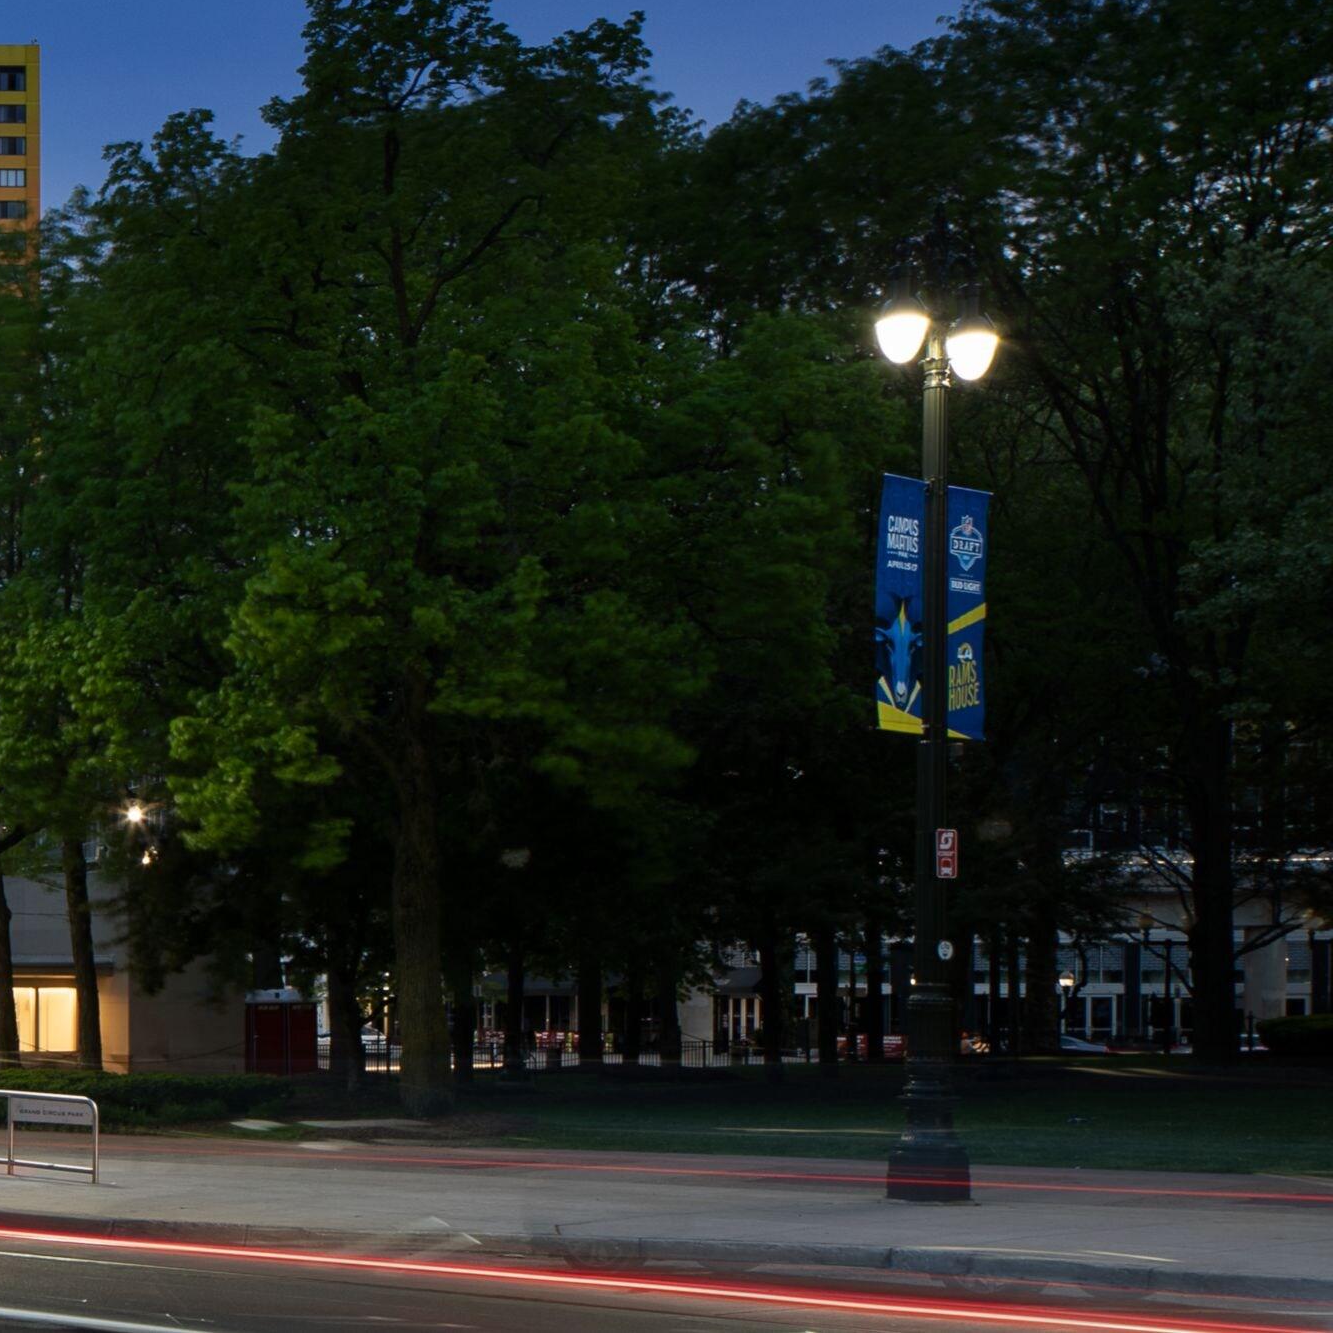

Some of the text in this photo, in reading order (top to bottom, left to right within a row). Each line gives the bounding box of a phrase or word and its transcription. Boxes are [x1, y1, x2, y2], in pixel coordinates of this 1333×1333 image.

[952, 539, 980, 553] DRAFT
[948, 659, 977, 687] RAMS
[948, 682, 981, 711] HOUSE
